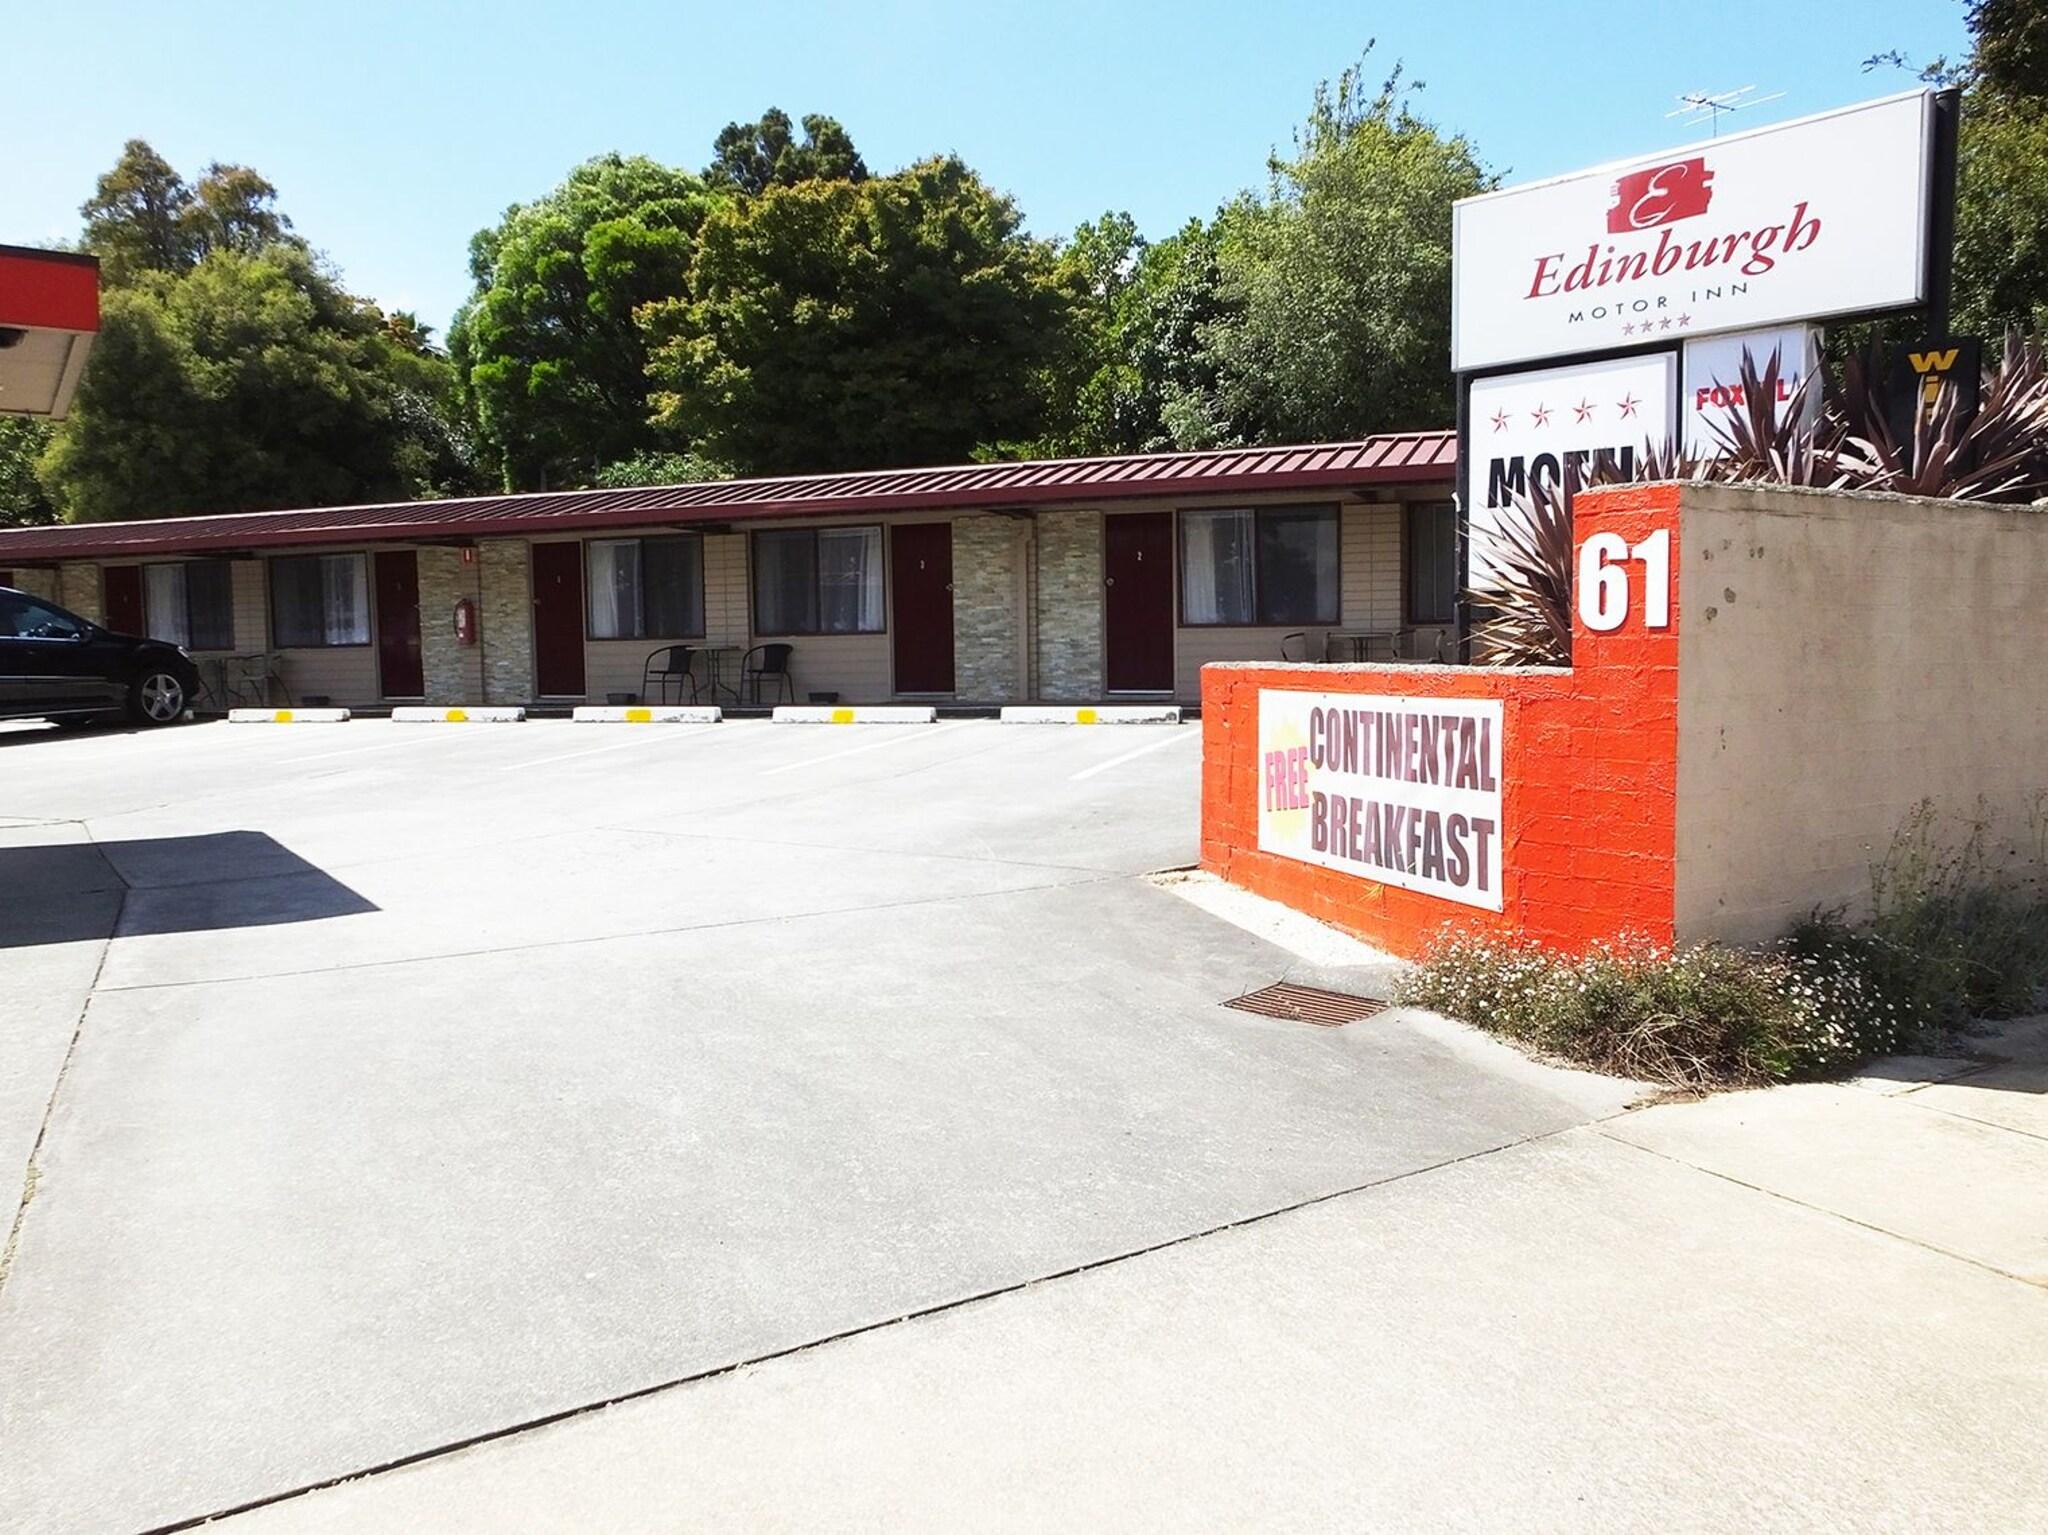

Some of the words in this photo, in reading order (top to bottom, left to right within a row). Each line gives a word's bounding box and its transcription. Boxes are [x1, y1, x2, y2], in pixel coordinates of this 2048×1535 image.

[1523, 201, 1822, 300] Edinburgh
[1567, 296, 1668, 323] MOTOR
[1691, 282, 1748, 303] INN
[1695, 378, 1791, 411] FOXL
[1578, 528, 1670, 632] 61
[1265, 746, 1310, 812] FREE
[1310, 706, 1497, 793] CONTINENTAL
[1311, 791, 1496, 892] BREAKFAST
